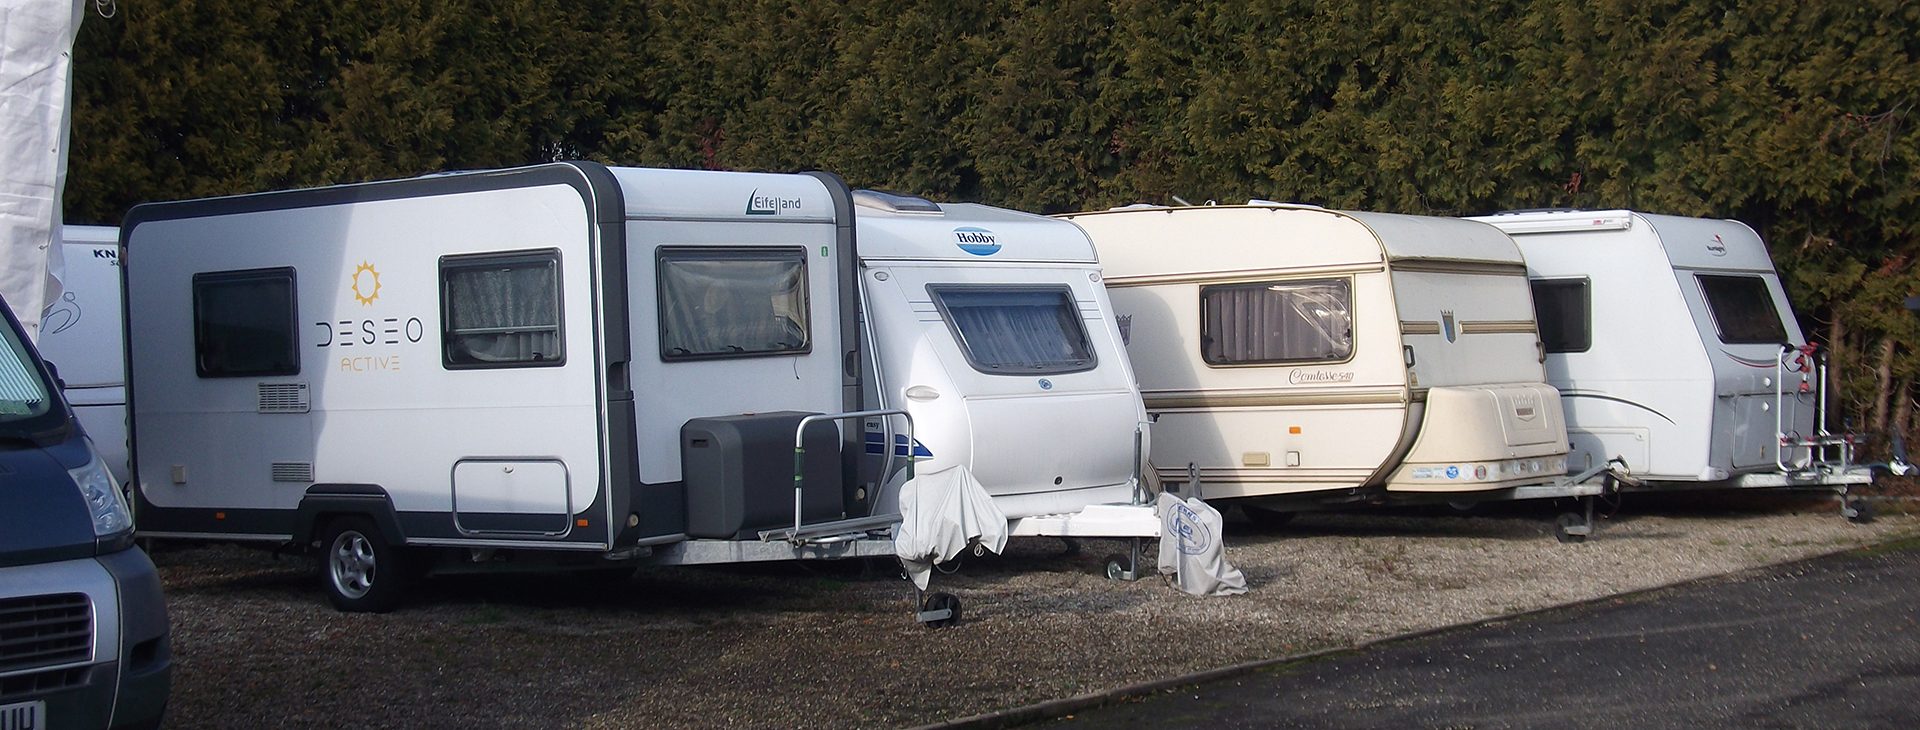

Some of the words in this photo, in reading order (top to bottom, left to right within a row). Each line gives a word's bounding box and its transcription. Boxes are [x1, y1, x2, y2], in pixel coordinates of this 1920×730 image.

[754, 196, 801, 216] Eifelland
[956, 232, 995, 247] Hobby
[93, 249, 117, 259] KN
[315, 317, 423, 348] DESEO
[340, 356, 400, 372] ACTIVE
[866, 421, 880, 430] easy
